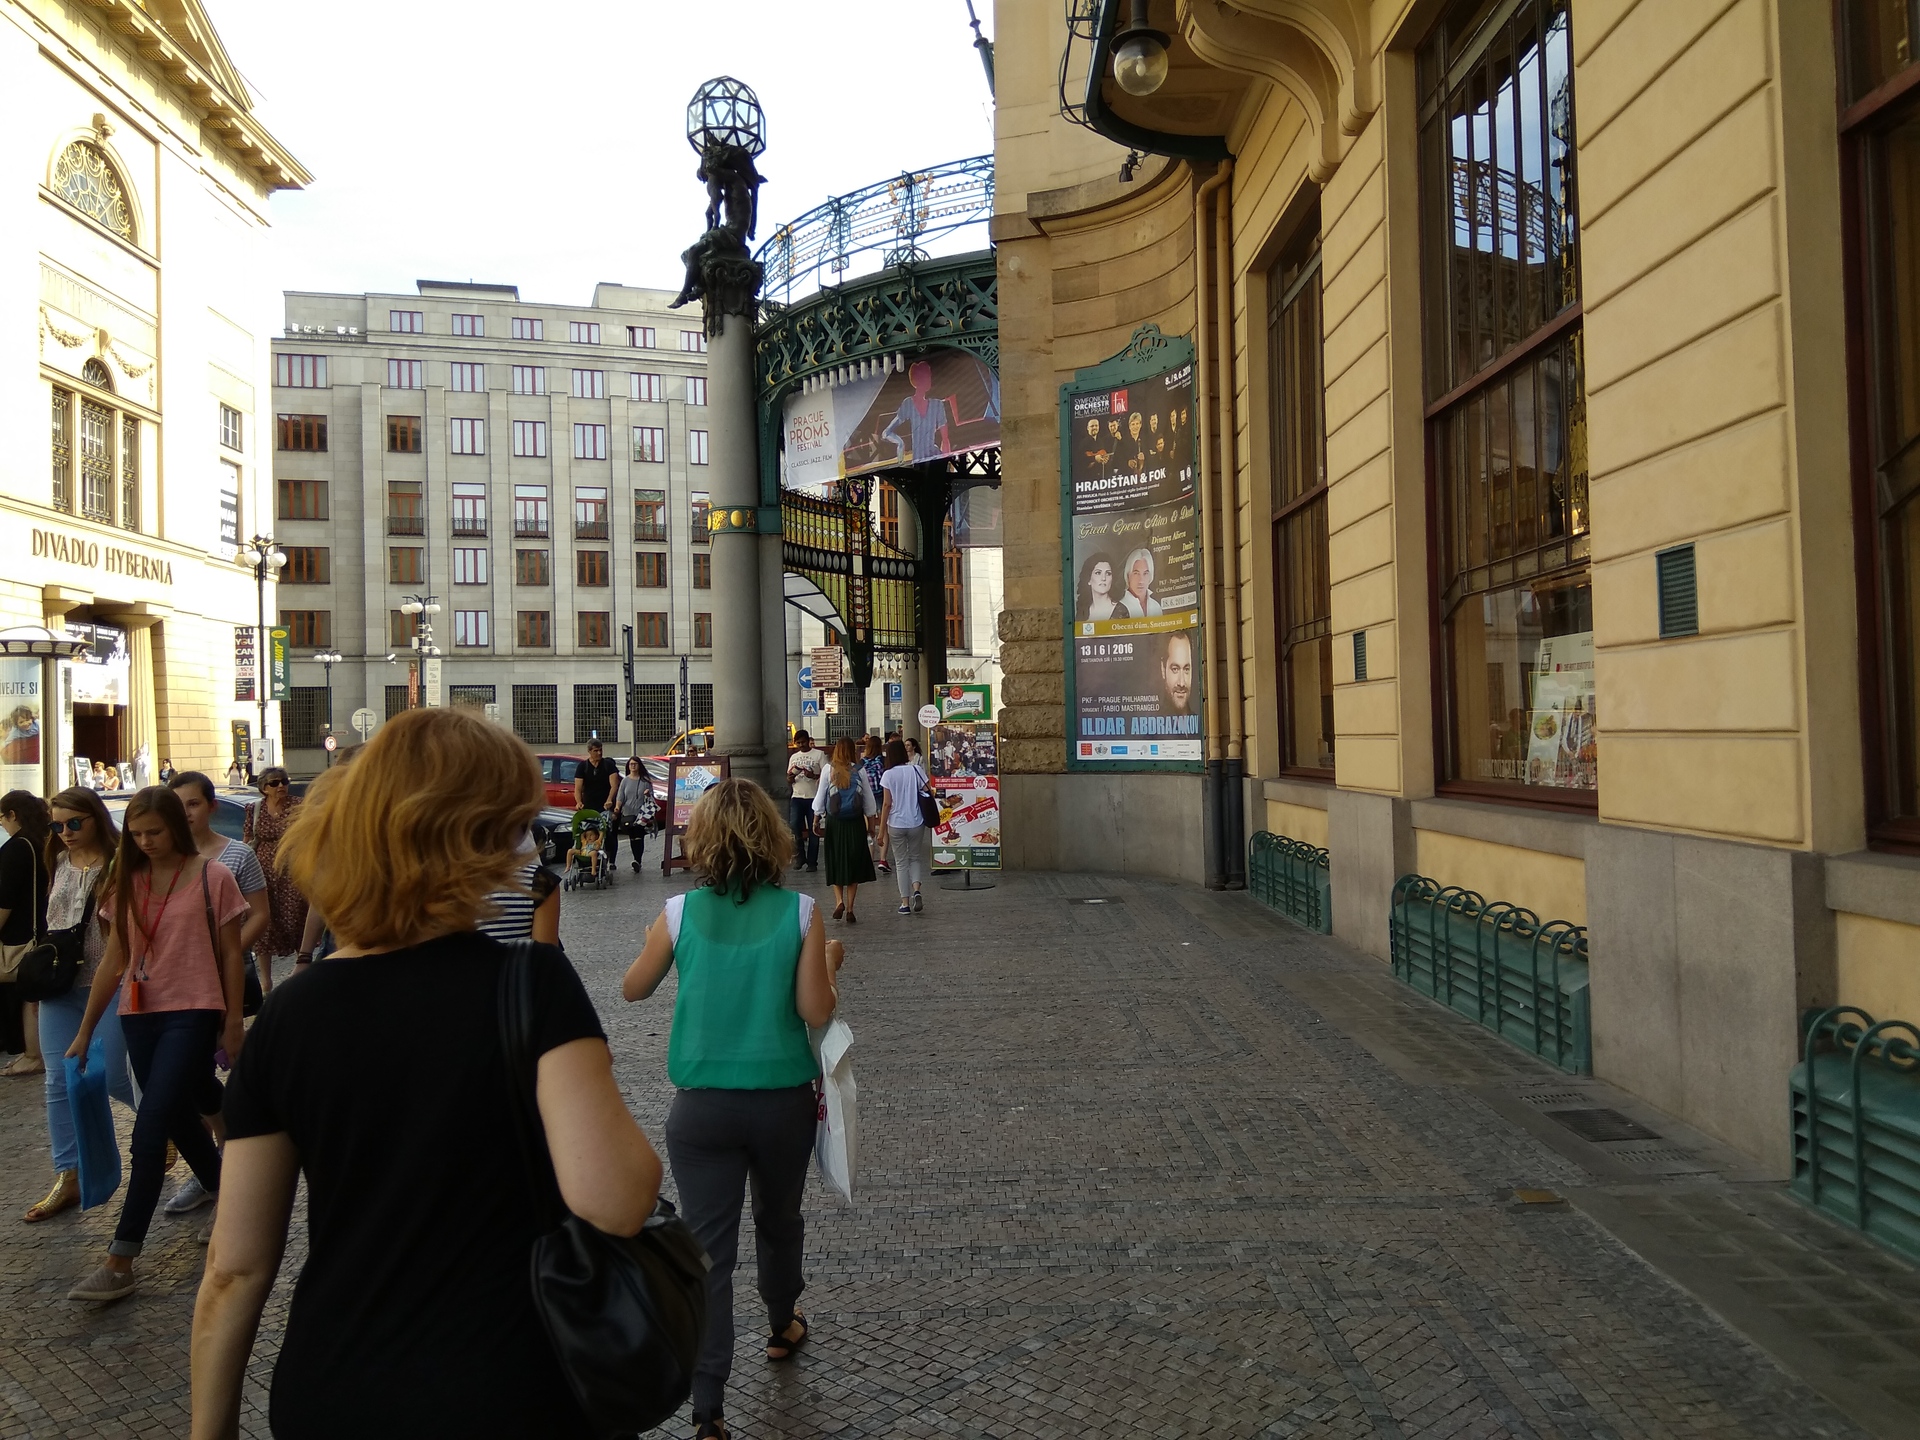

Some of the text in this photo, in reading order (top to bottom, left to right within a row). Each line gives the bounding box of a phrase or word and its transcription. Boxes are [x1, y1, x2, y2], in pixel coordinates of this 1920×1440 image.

[1074, 400, 1110, 411] ORCHESTR
[1091, 406, 1110, 414] PRAHY
[793, 411, 824, 428] PRAGUE
[790, 422, 830, 446] PROMS
[797, 440, 822, 452] FESTIVAL
[1075, 467, 1166, 493] HRADIŠŤAN & FOK
[1078, 521, 1108, 540] Great
[1112, 518, 1141, 535] Opera
[1151, 535, 1171, 545] Dinara
[1153, 544, 1171, 553] soprano
[32, 528, 173, 585] DIVADLO HYBERNIA
[1111, 623, 1134, 631] Obecní
[1150, 619, 1176, 629] Smetanova
[1080, 645, 1091, 656] 13
[1099, 645, 1105, 655] 6
[1112, 643, 1134, 655] 2016
[274, 640, 284, 679] SUBWAY
[29, 682, 38, 695] SI
[892, 686, 900, 696] P
[1122, 695, 1160, 703] PHILHARMONIA
[1103, 704, 1120, 712] FABIO
[1121, 703, 1160, 712] MASTRANGELO
[1081, 715, 1199, 736] ILDAR ABDRAZAKOV
[690, 770, 702, 782] 500
[975, 779, 987, 788] 500
